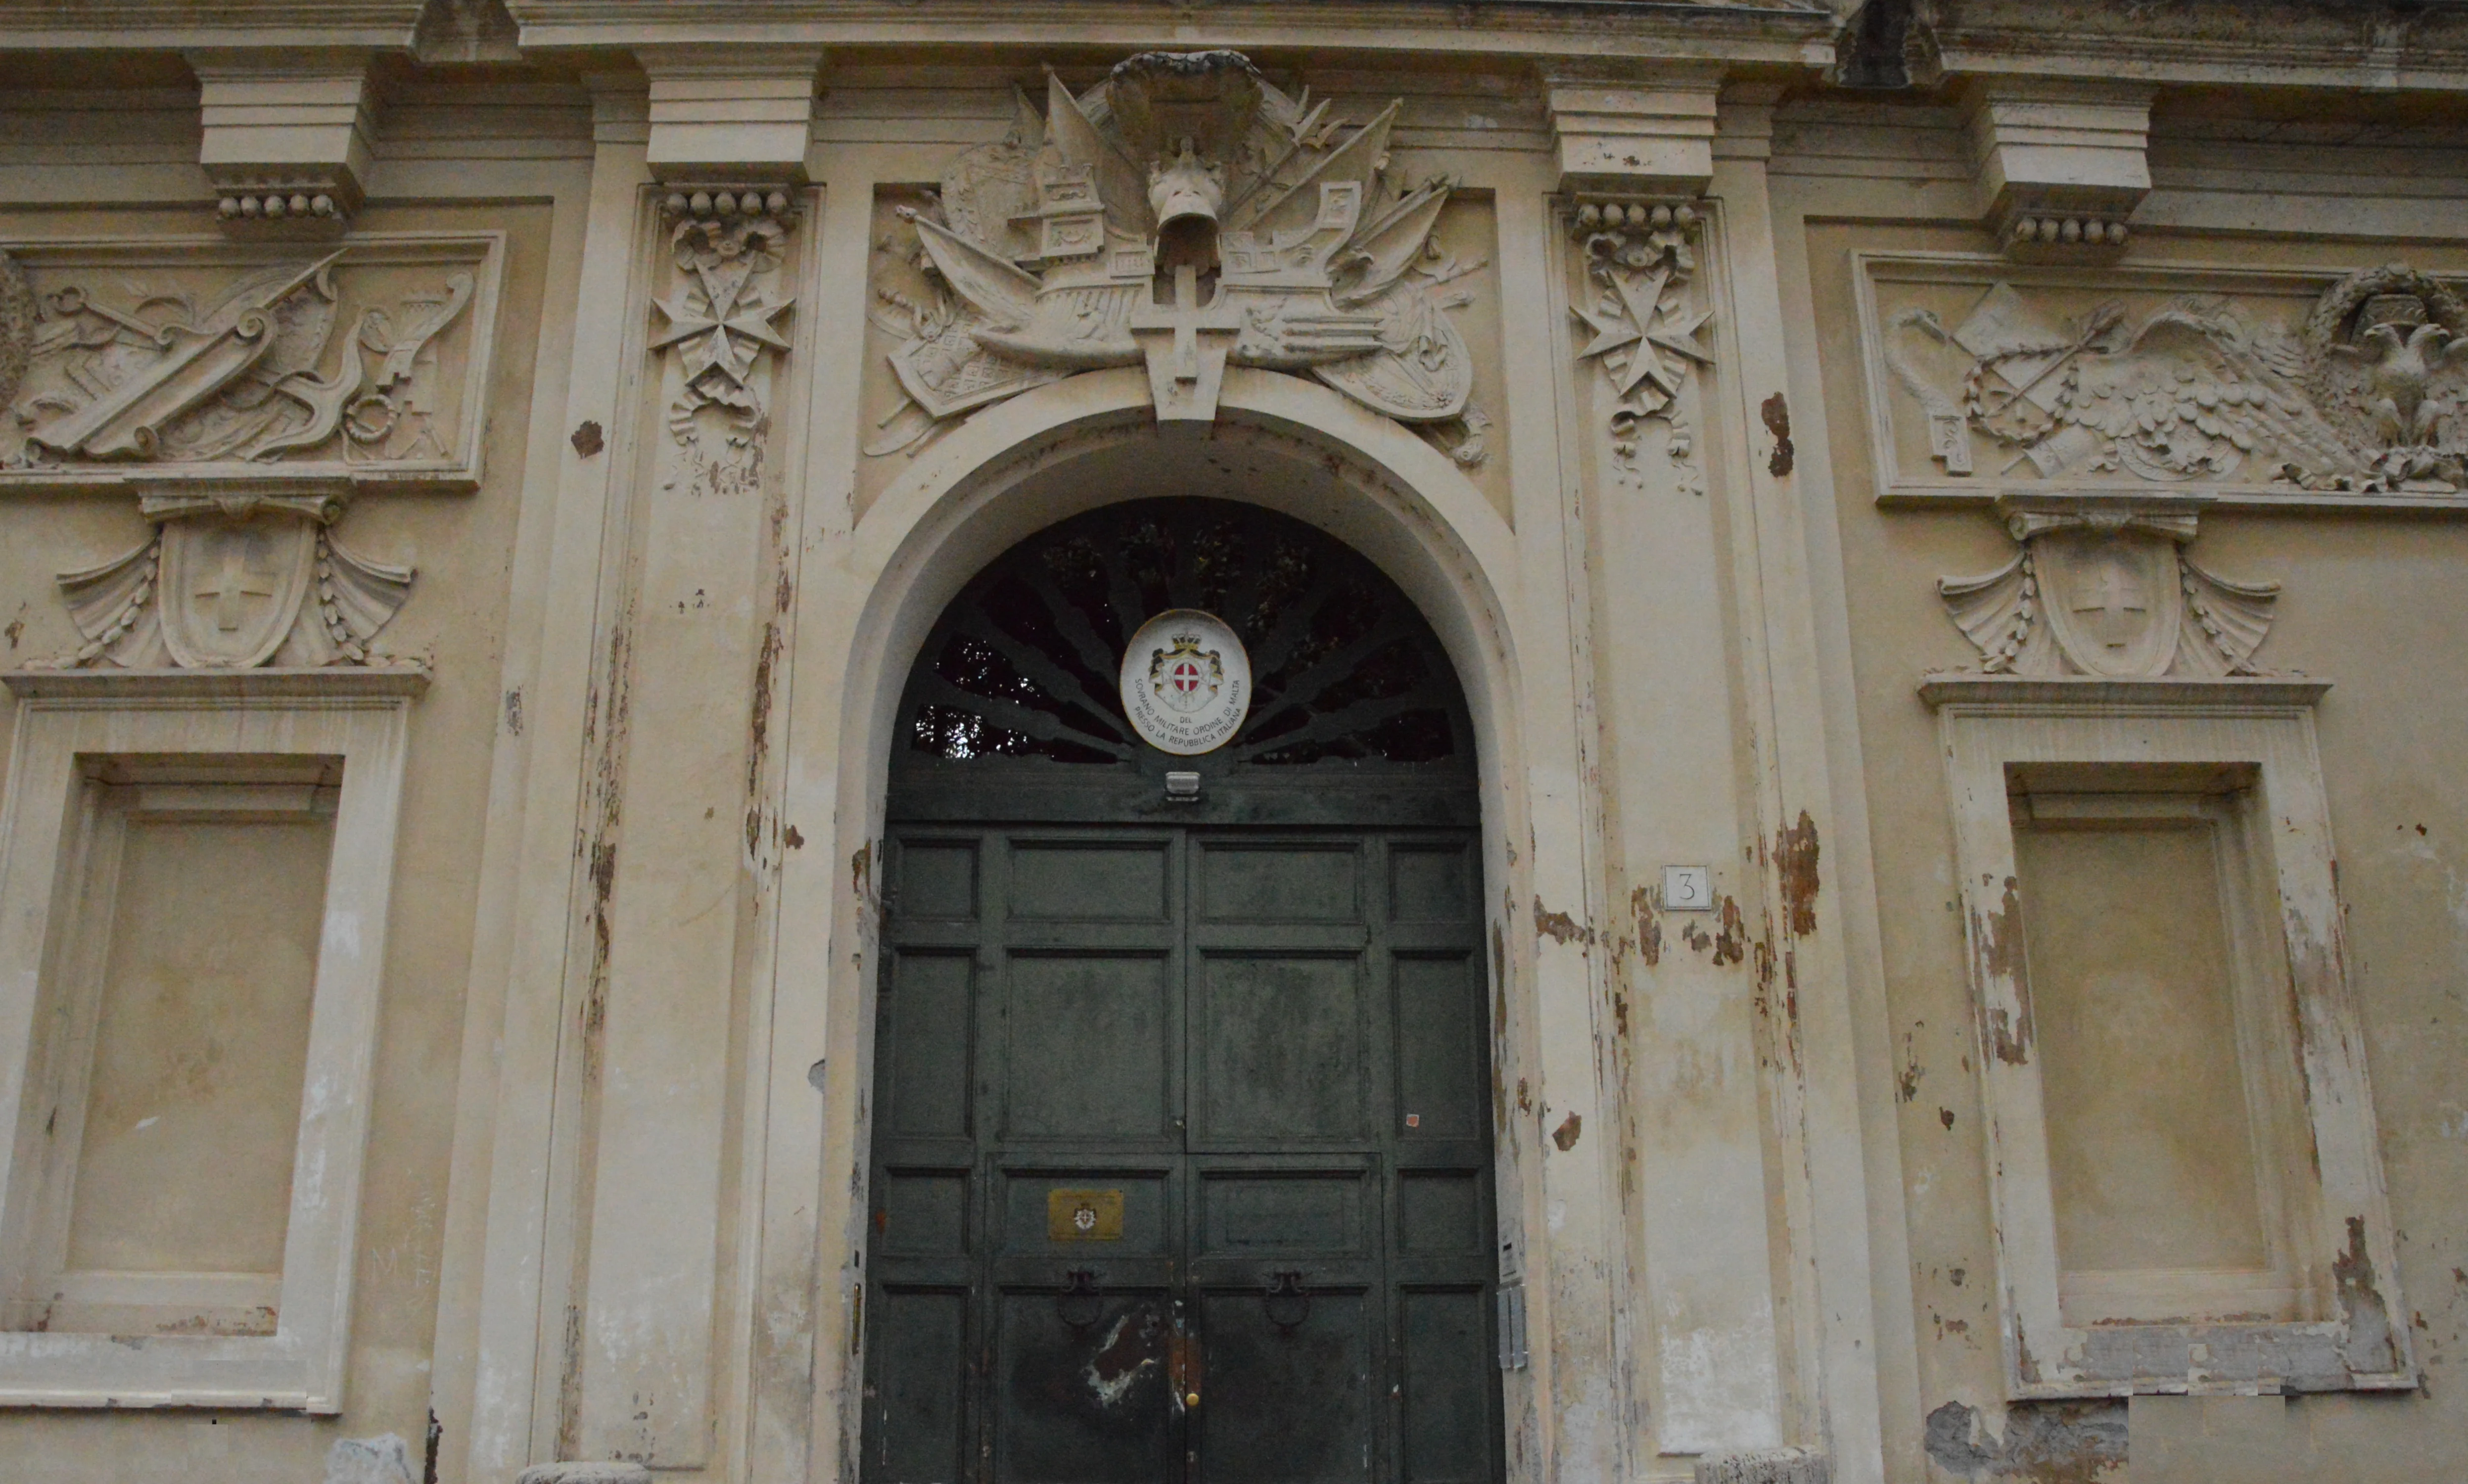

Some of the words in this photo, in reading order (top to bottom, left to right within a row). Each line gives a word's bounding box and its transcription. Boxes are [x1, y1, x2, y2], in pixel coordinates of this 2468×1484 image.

[1134, 706, 1155, 732] PRESSO
[1156, 730, 1165, 741] LA
[1168, 733, 1216, 747] REPUBBLICA
[1216, 708, 1241, 737] ITALIANA
[1135, 678, 1155, 715] SOVRANO
[1154, 715, 1189, 736] MILITARE
[1193, 717, 1224, 735] ORDINE
[1223, 706, 1232, 717] DI
[1229, 680, 1240, 705] MALTA
[1679, 874, 1695, 900] 3
